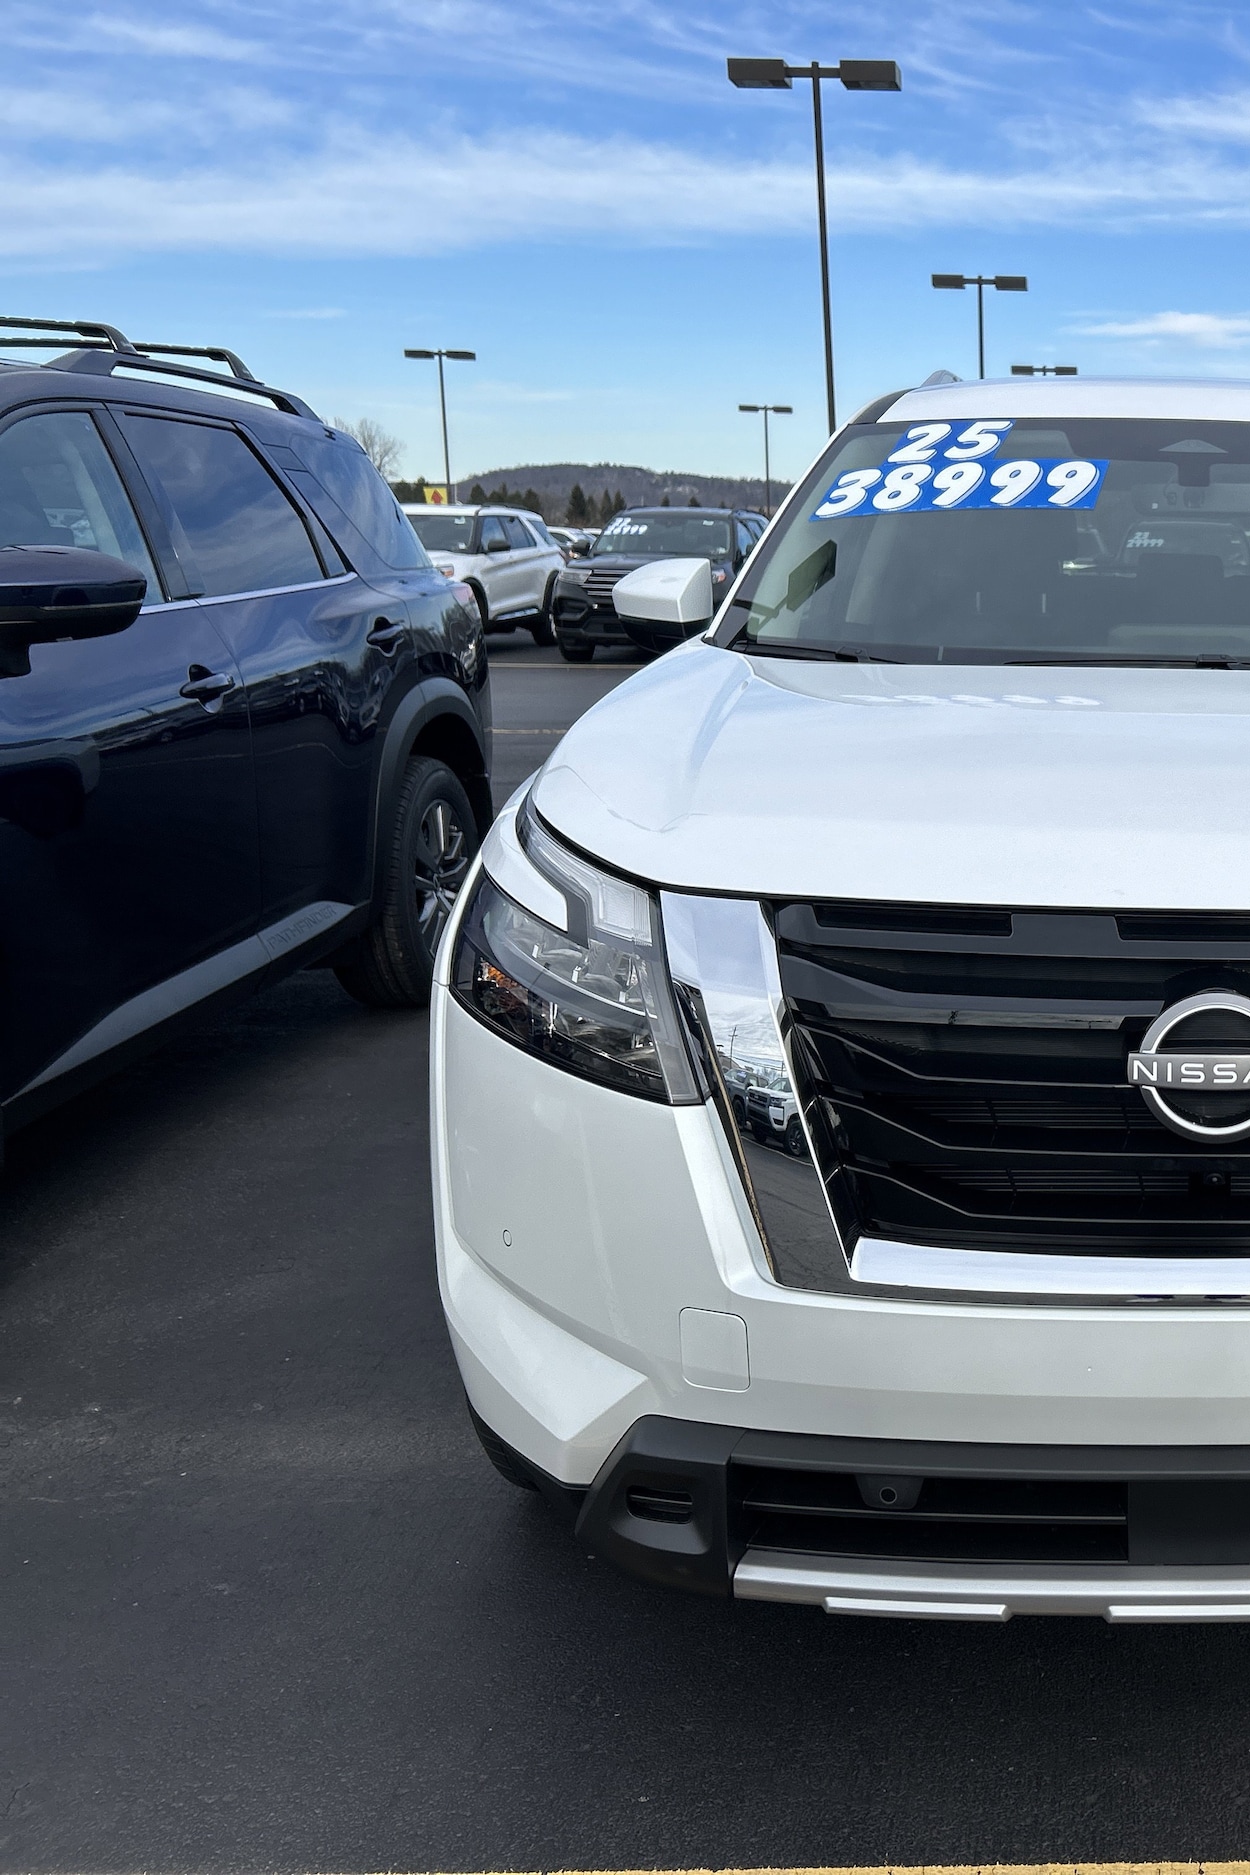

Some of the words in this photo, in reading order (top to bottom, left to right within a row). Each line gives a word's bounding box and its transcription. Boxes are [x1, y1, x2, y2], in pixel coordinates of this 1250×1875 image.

[887, 420, 1014, 464] 25
[814, 459, 1101, 519] 38999
[266, 904, 337, 950] PATHFINDER
